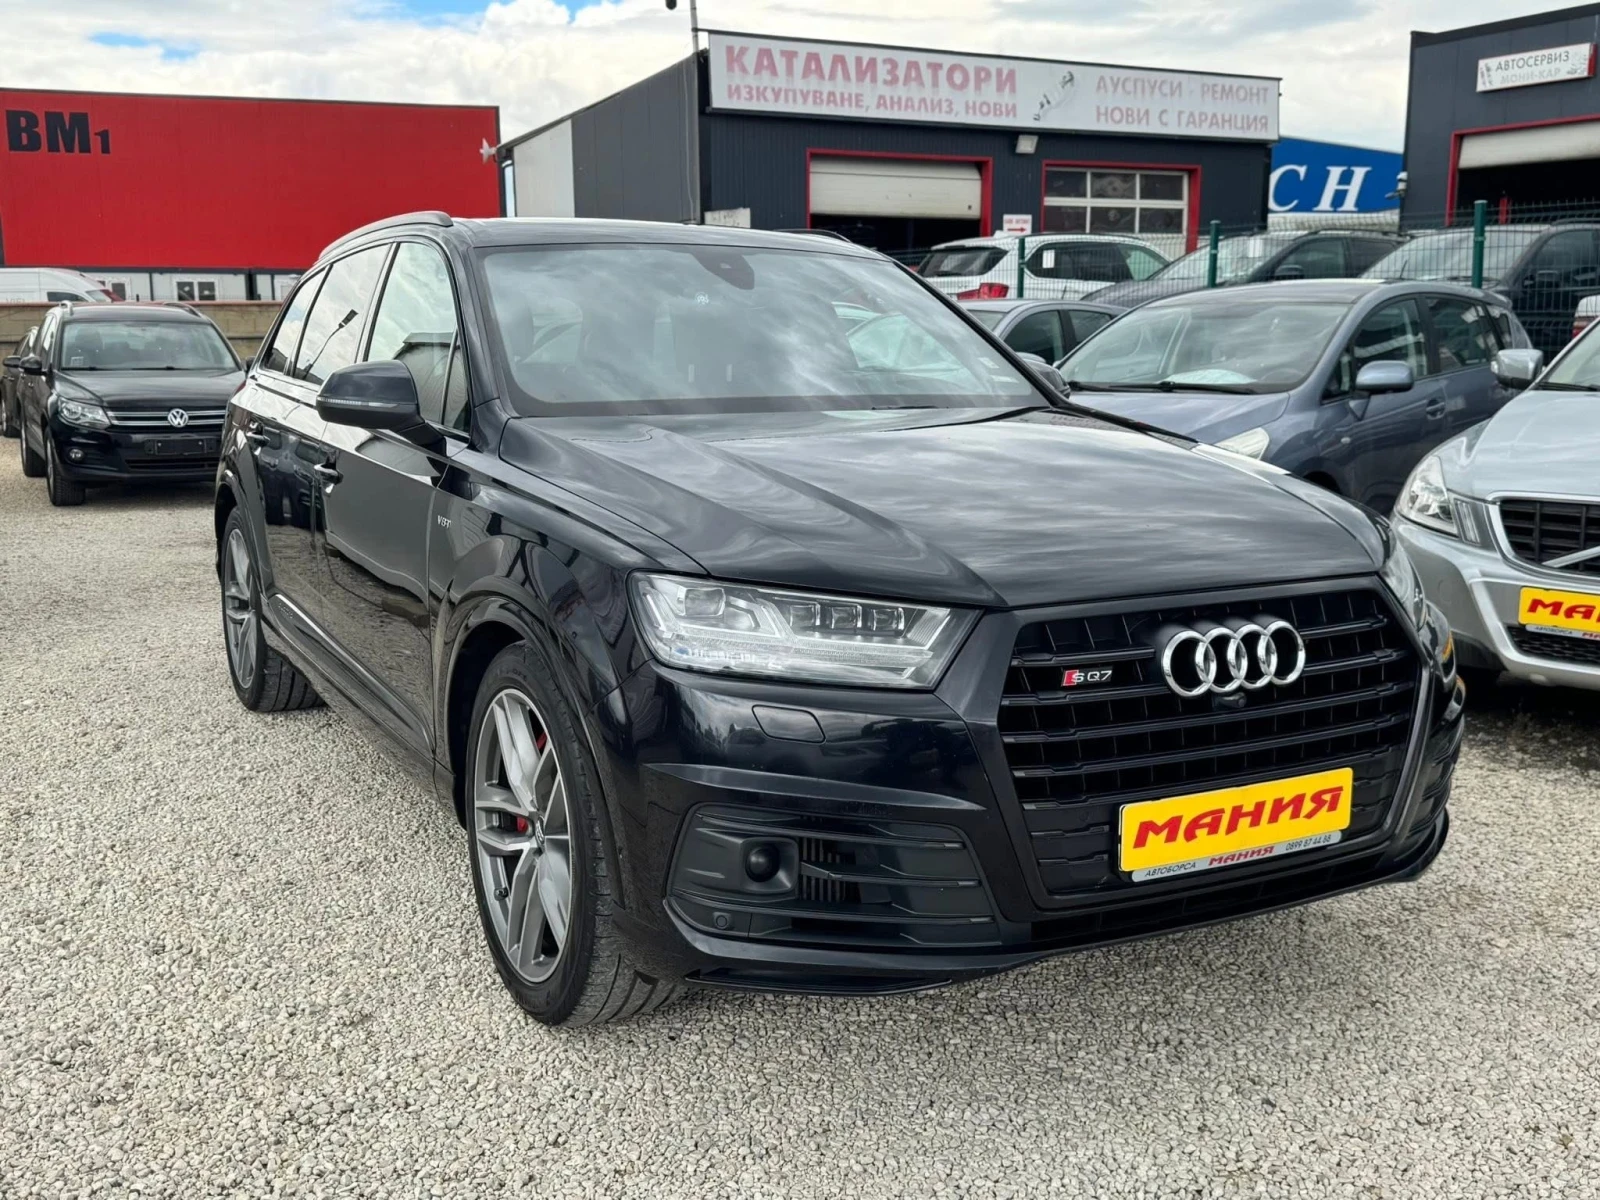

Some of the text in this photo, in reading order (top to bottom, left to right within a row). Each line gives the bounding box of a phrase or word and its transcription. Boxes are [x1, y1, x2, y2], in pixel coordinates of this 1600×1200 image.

[725, 45, 1016, 94] КАТАЛИЗАТОРИ
[1496, 51, 1570, 72] АВТОСЕРВИЗ
[727, 84, 1017, 118] ИЗКУПУВАНЕ, АНАЛИЗ, НОВИ
[1201, 83, 1269, 105] РЕМОНТ
[1096, 105, 1150, 126] НОВИ
[1177, 110, 1269, 133] ГАРАНЦИЯ
[1527, 598, 1600, 623] МА
[1133, 786, 1343, 848] МАНИЯ
[1145, 861, 1197, 877] АВТОБОРСА
[1208, 846, 1275, 866] МАНИЯ
